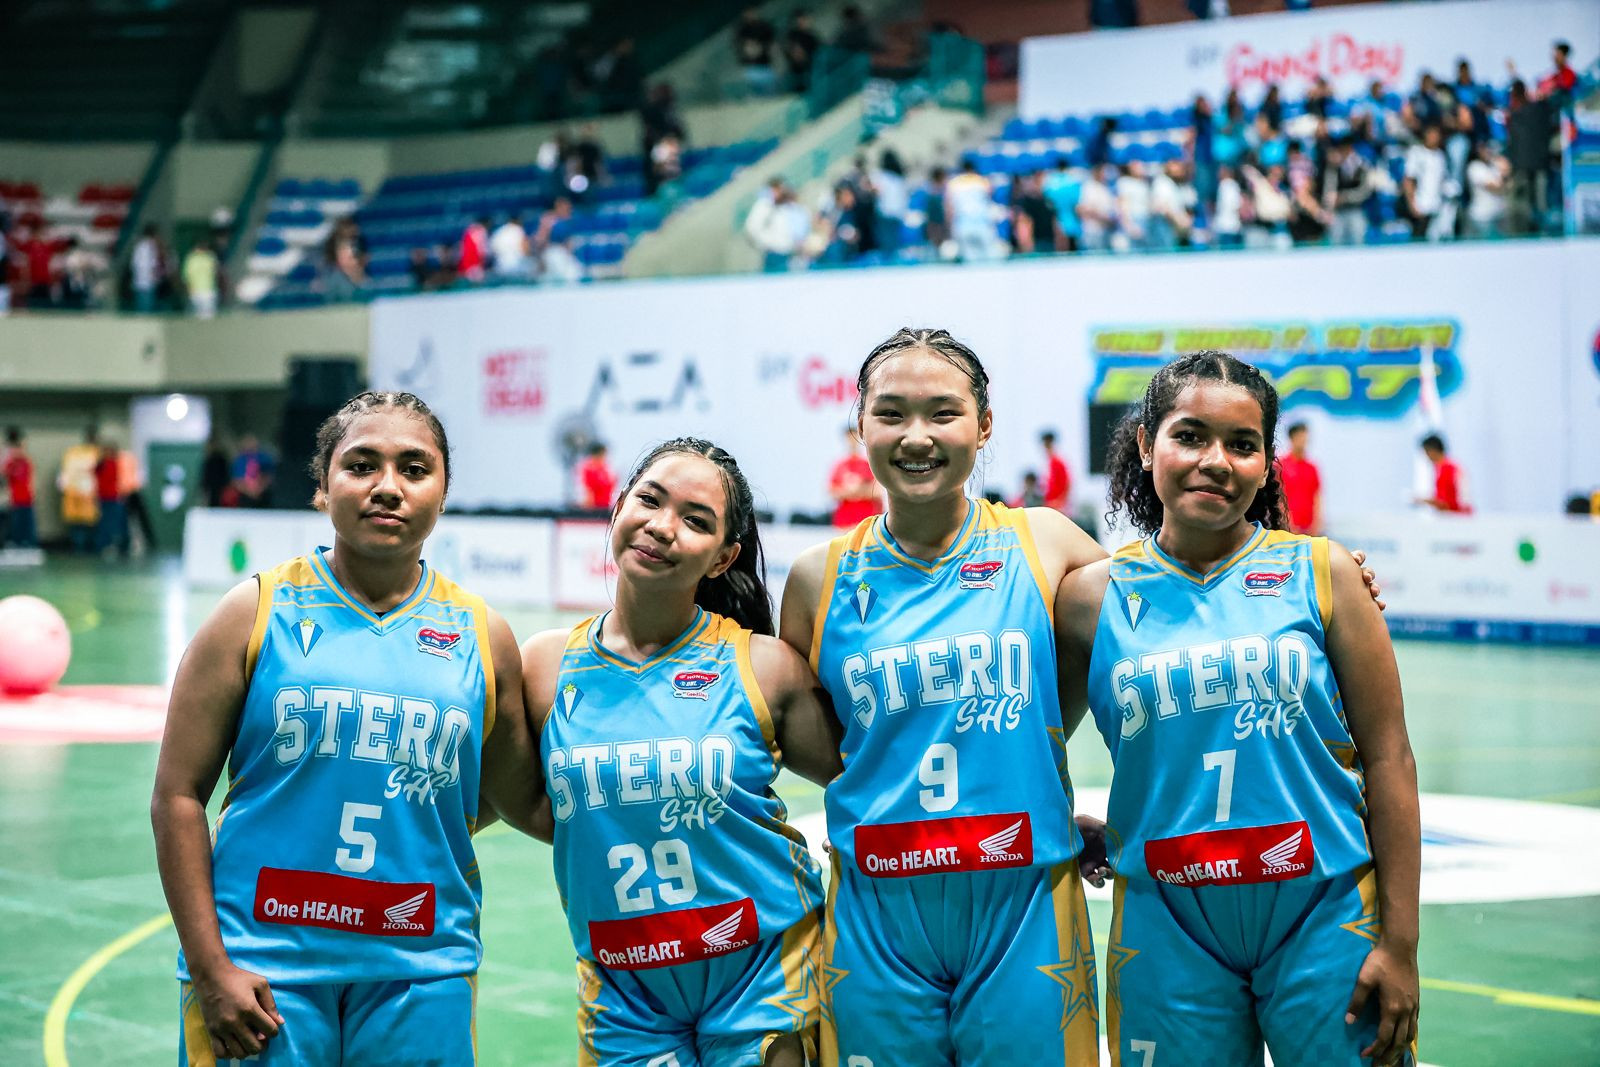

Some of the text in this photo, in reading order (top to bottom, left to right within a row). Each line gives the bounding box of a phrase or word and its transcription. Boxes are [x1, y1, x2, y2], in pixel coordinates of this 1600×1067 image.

[1331, 34, 1403, 82] Day
[842, 629, 1032, 733] STERO
[1111, 634, 1310, 741] STERO
[955, 695, 1022, 734] SHS
[1234, 701, 1307, 741] SHS
[273, 685, 471, 788] STERO
[549, 734, 735, 824] STERO
[919, 743, 959, 813] 9
[1203, 749, 1237, 823] 7
[659, 796, 728, 833] SHS
[335, 801, 383, 873] 5
[607, 838, 698, 913] 29
[866, 846, 961, 872] One HEART.
[980, 853, 1024, 863] HONDA
[1156, 858, 1243, 884] One HEART.
[1262, 862, 1306, 875] HONDA
[263, 897, 364, 927] One HEART.
[382, 922, 425, 931] HONDA
[599, 939, 685, 966] One HEART.
[703, 939, 749, 954] HONDA
